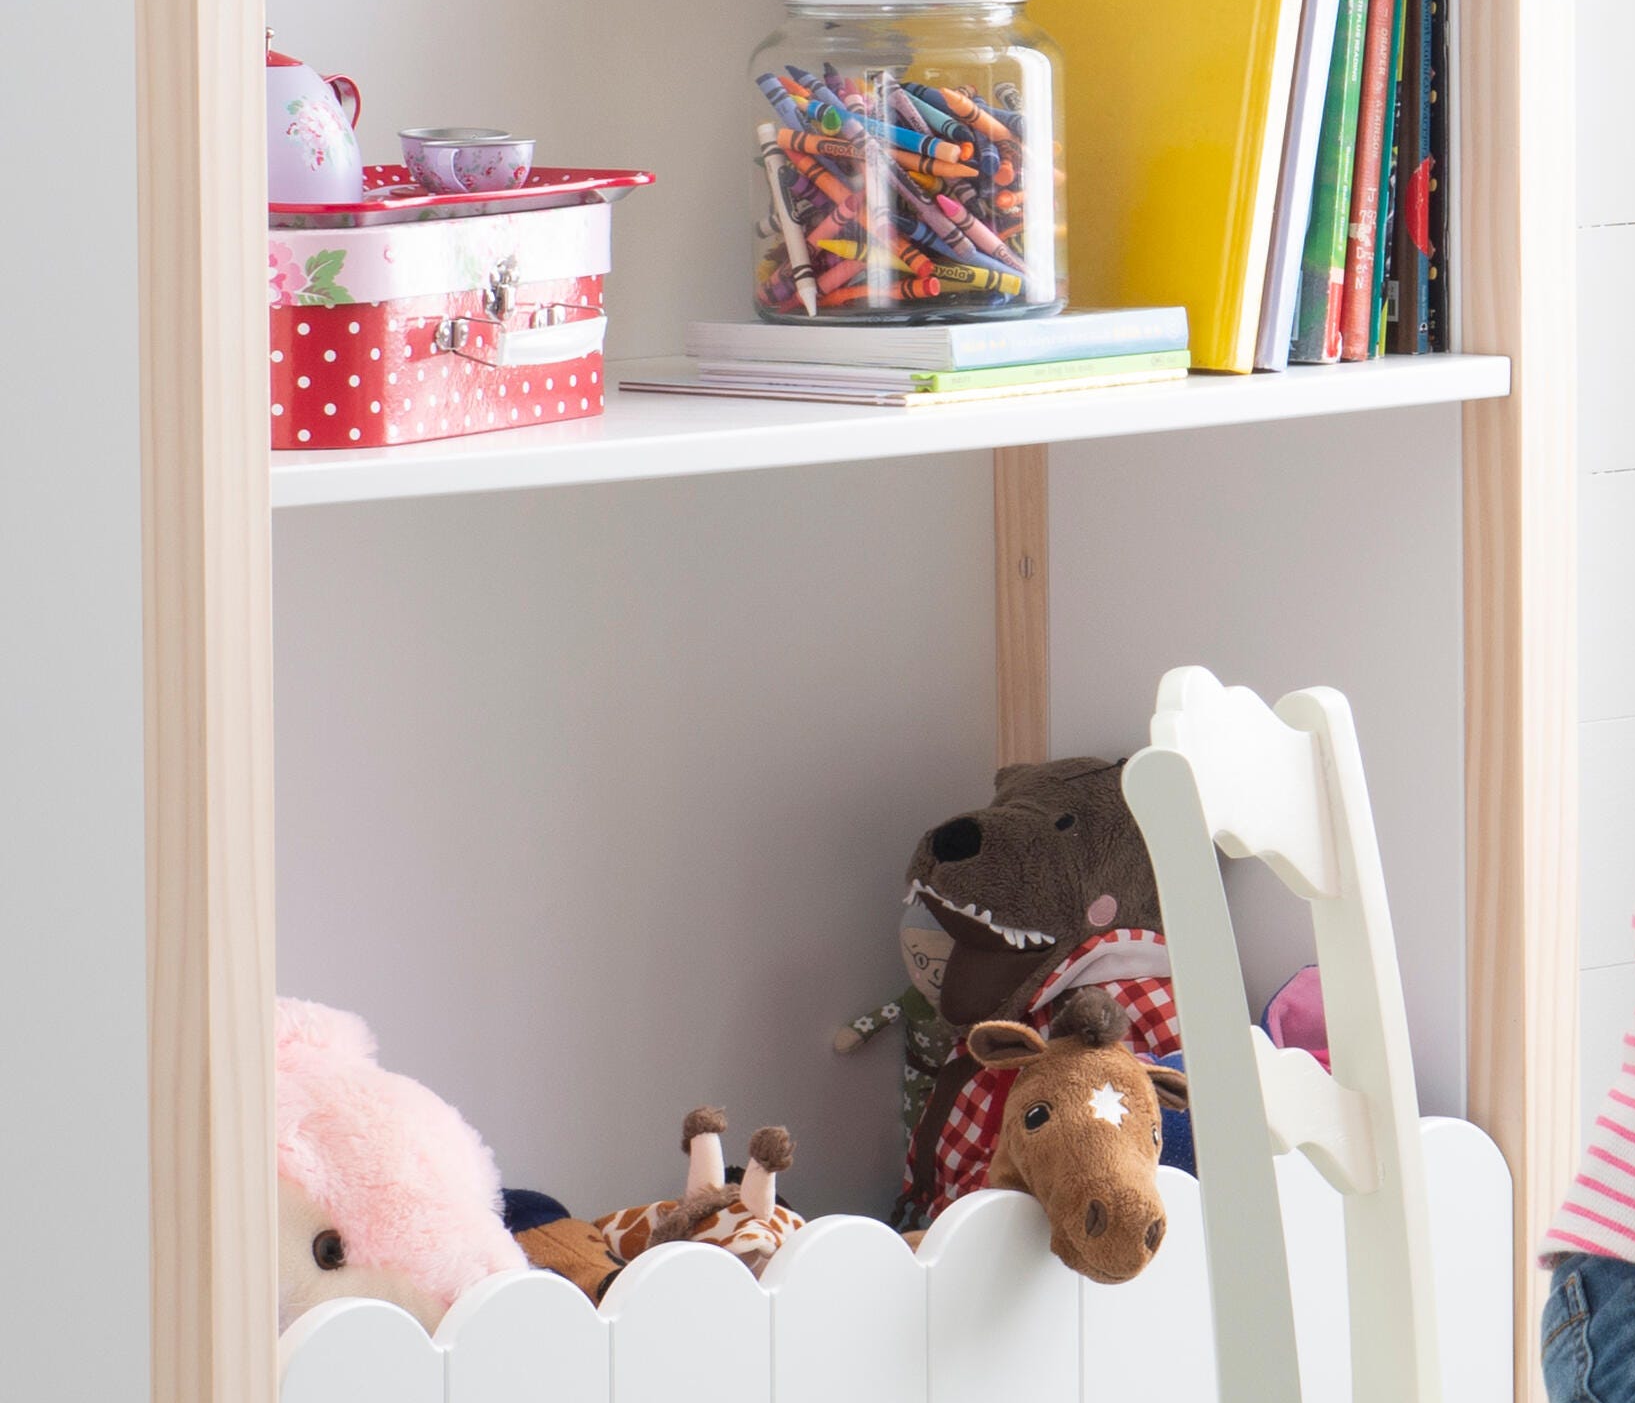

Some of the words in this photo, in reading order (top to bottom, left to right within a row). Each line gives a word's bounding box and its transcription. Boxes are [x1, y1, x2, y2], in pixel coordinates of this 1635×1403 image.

[1352, 39, 1360, 81] READING
[1378, 27, 1388, 75] DRAPER
[1372, 99, 1381, 158] ATKINSON
